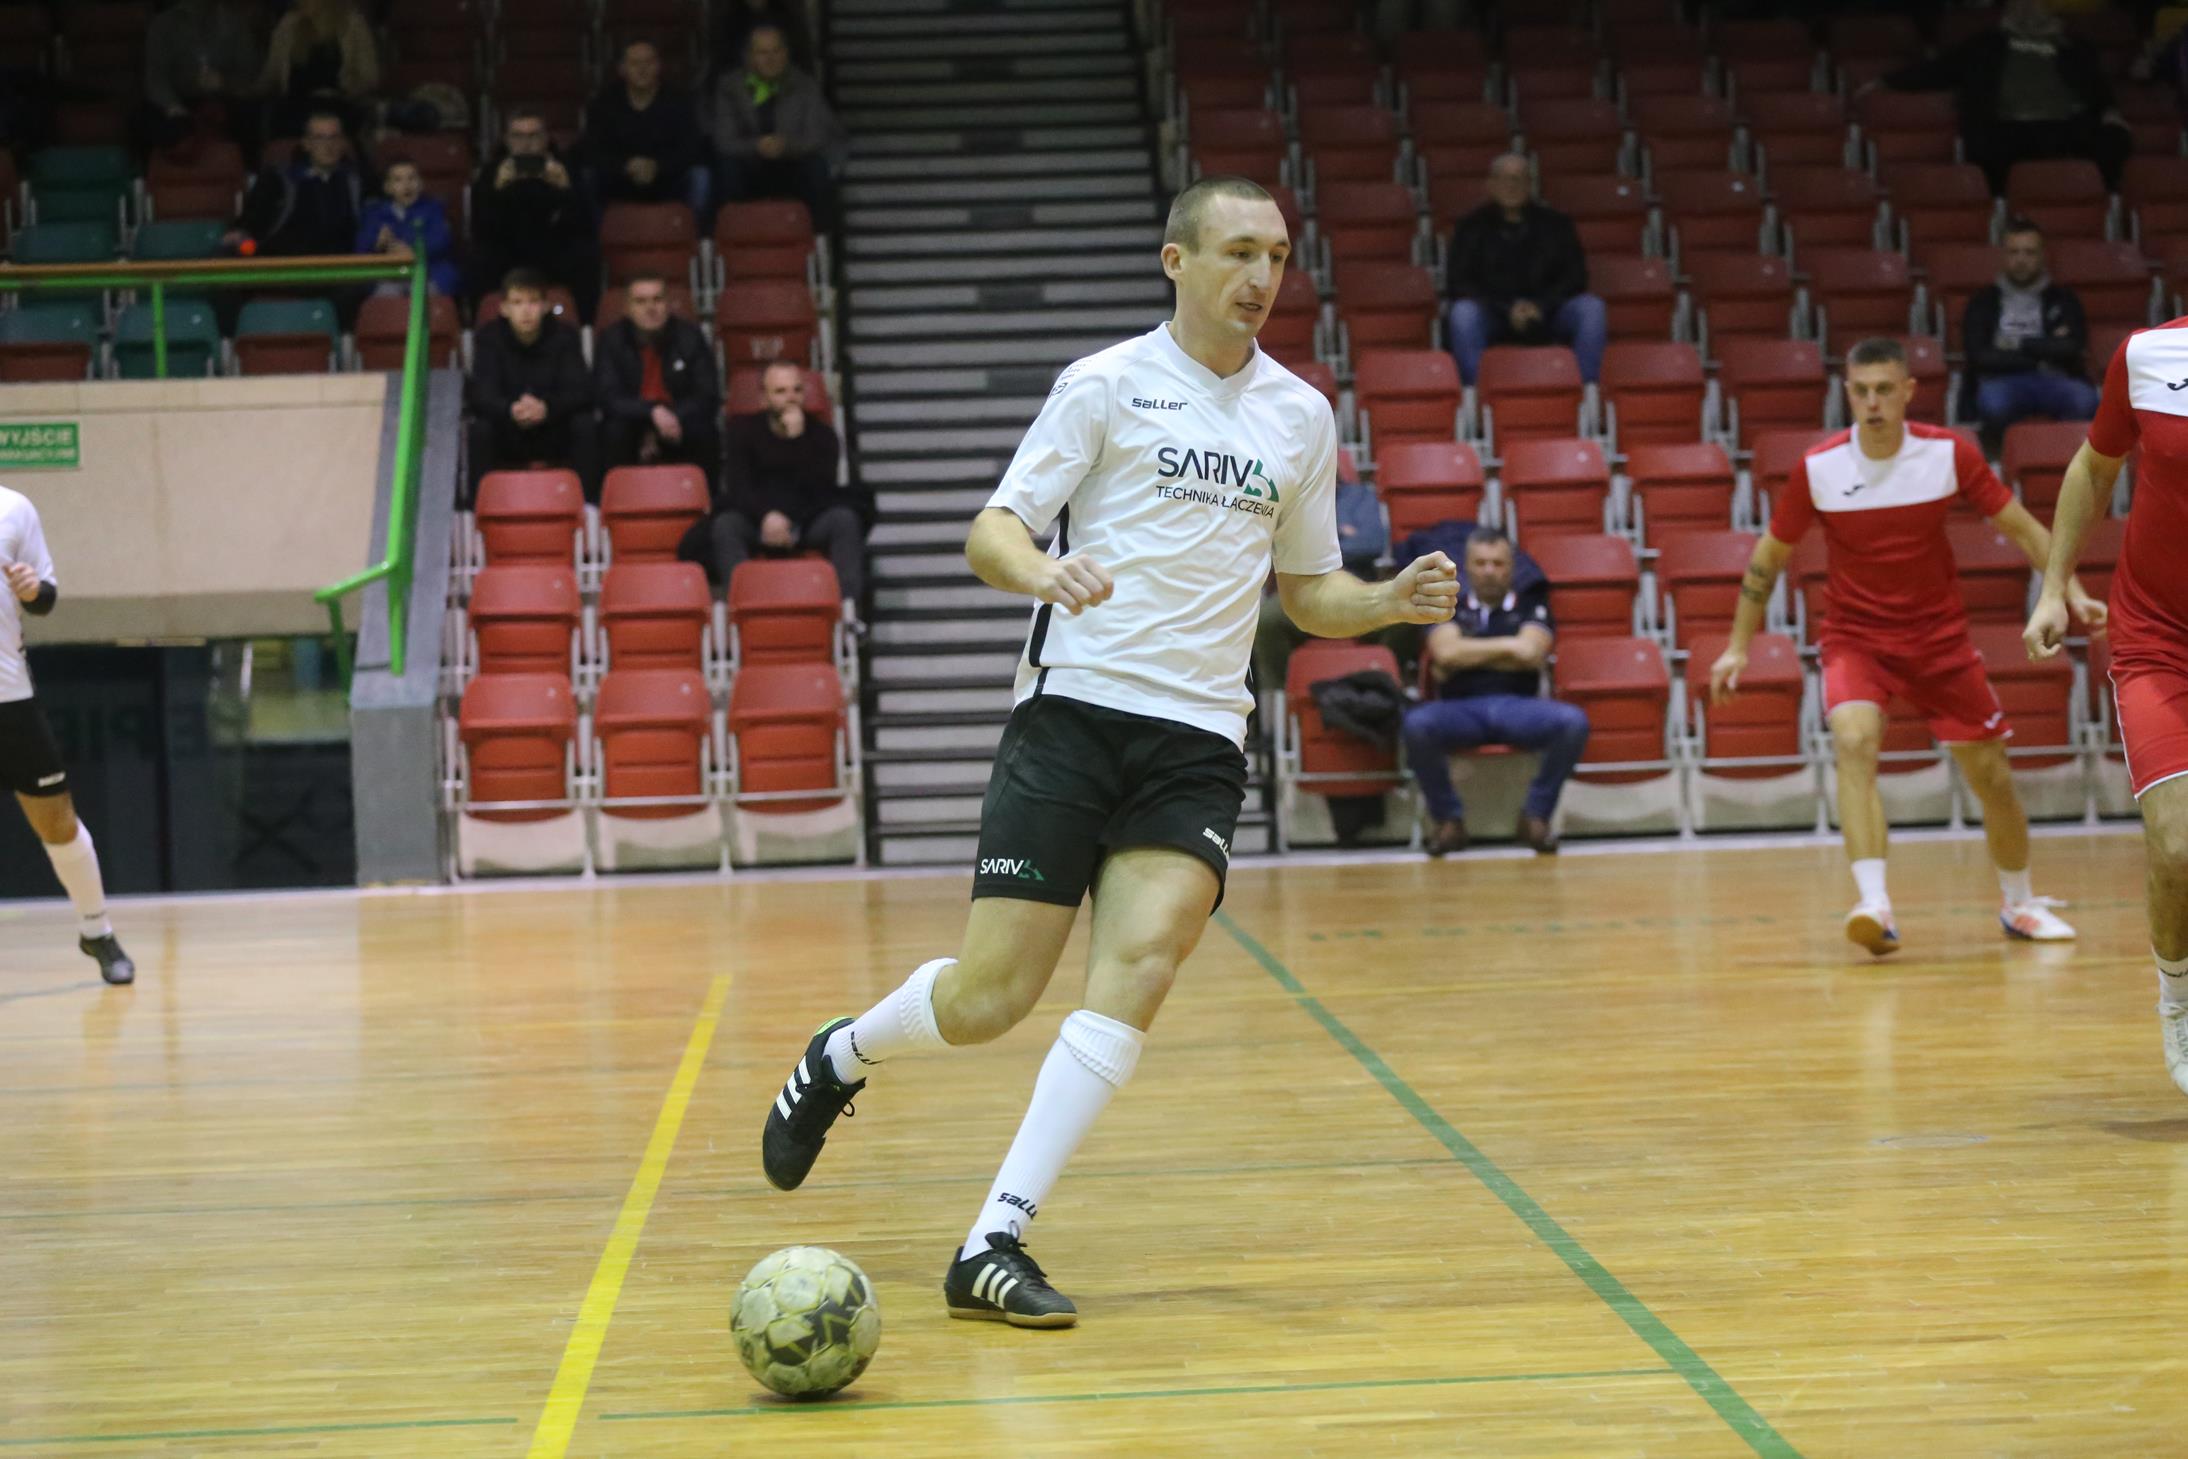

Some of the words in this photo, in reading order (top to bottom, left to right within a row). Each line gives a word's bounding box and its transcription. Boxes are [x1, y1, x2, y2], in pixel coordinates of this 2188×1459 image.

[1131, 397, 1188, 411] saller
[1155, 485, 1220, 506] TECHNIKA
[1221, 496, 1275, 519] ŁĄCZENIA
